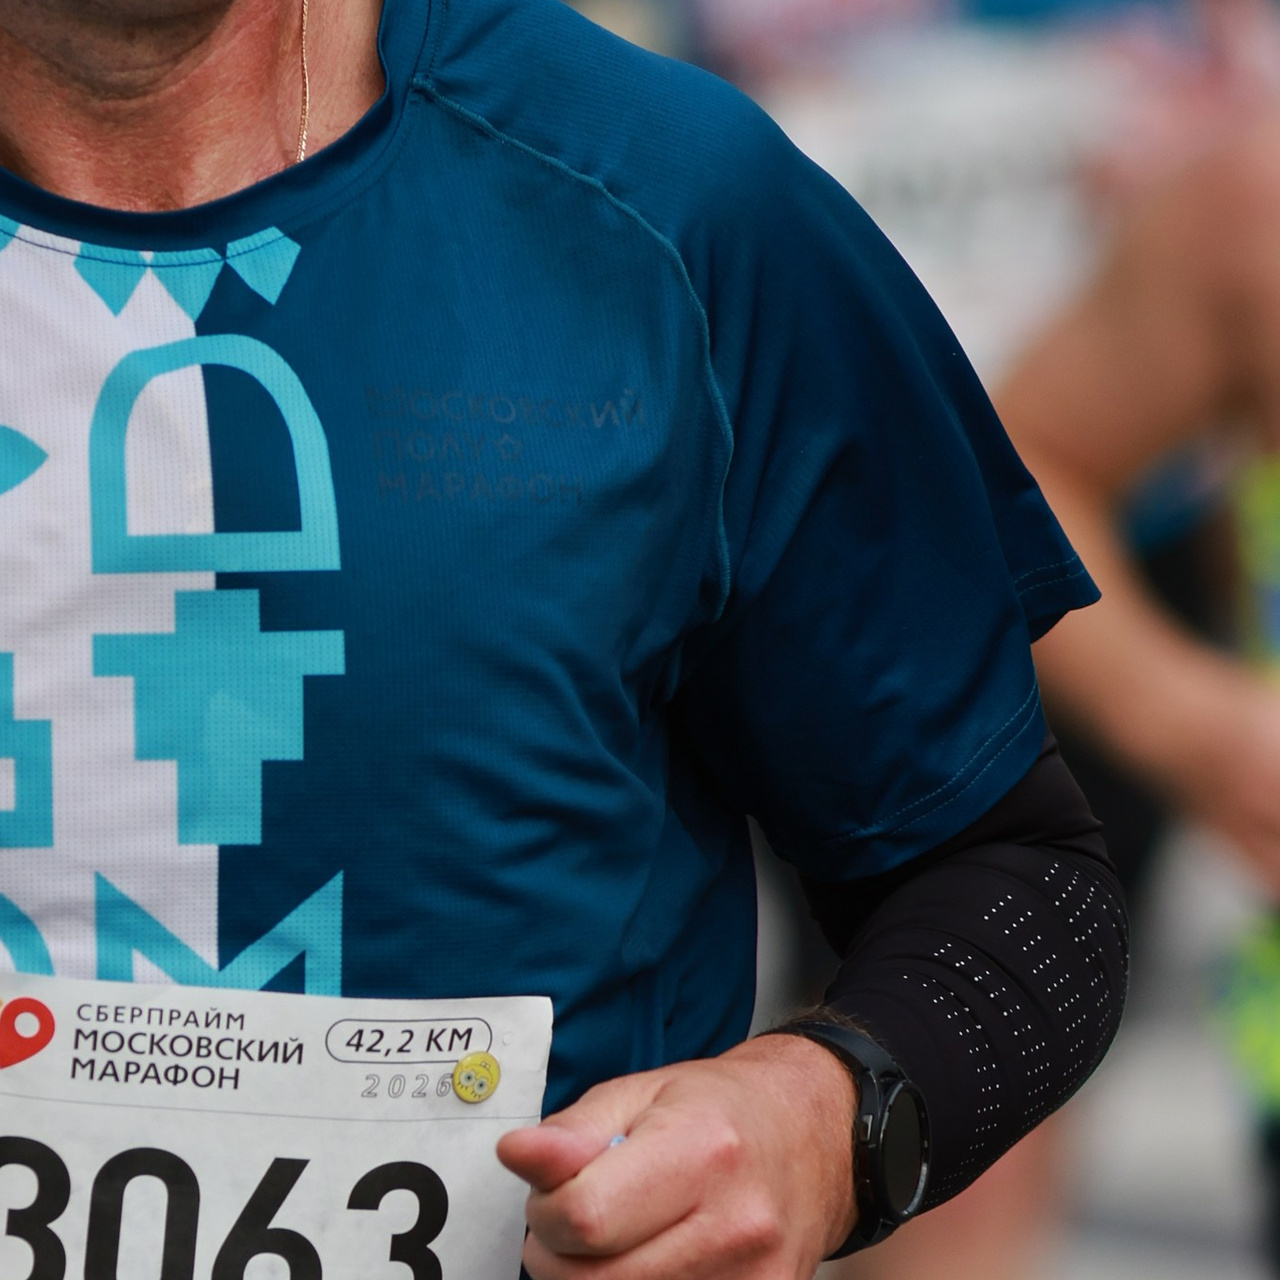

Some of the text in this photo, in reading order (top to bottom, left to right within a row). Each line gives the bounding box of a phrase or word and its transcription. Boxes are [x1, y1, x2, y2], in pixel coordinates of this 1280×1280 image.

[76, 1003, 245, 1031] СБЕРПРАЙМ
[73, 1028, 304, 1065] МОСКОВСКИЙ
[345, 1027, 473, 1058] 42,2 КМ
[70, 1057, 240, 1090] МАРАФОН
[361, 1073, 453, 1099] 2026
